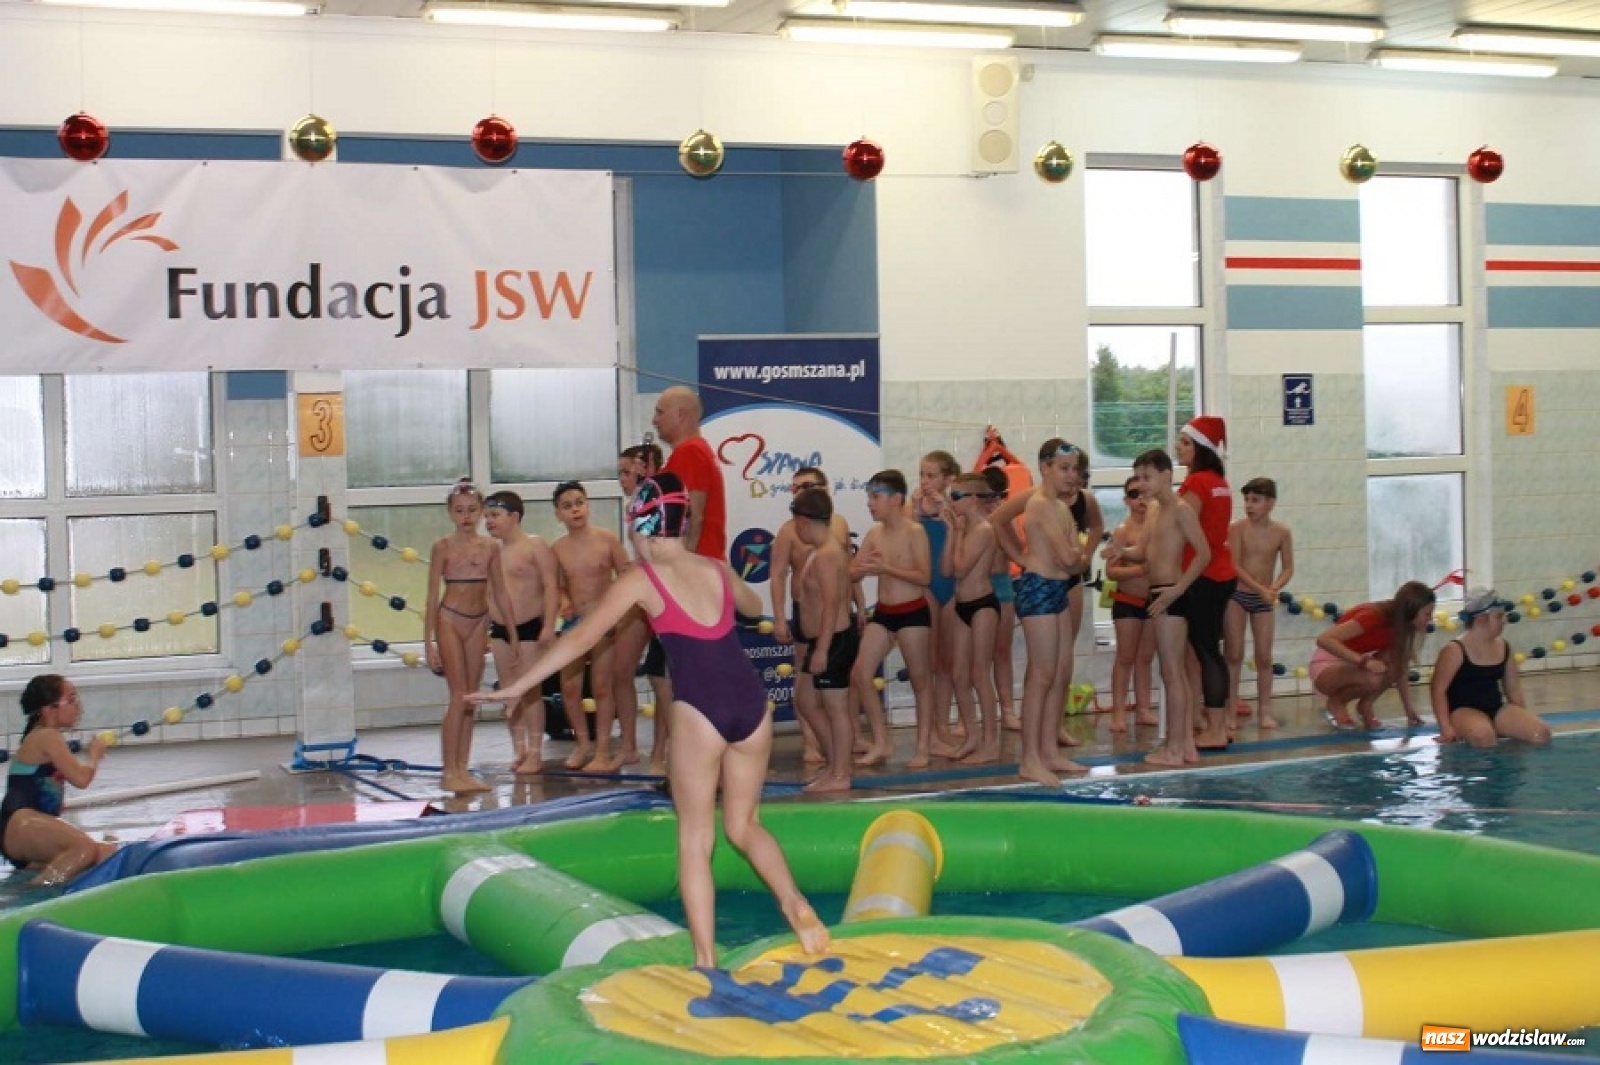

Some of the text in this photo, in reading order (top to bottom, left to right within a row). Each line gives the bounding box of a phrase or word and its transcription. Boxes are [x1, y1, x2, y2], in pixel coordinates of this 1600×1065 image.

[166, 262, 593, 339] Fundacja JSW
[713, 359, 865, 383] www.gosmszana.pl
[309, 399, 333, 452] 3
[1512, 388, 1530, 433] 4
